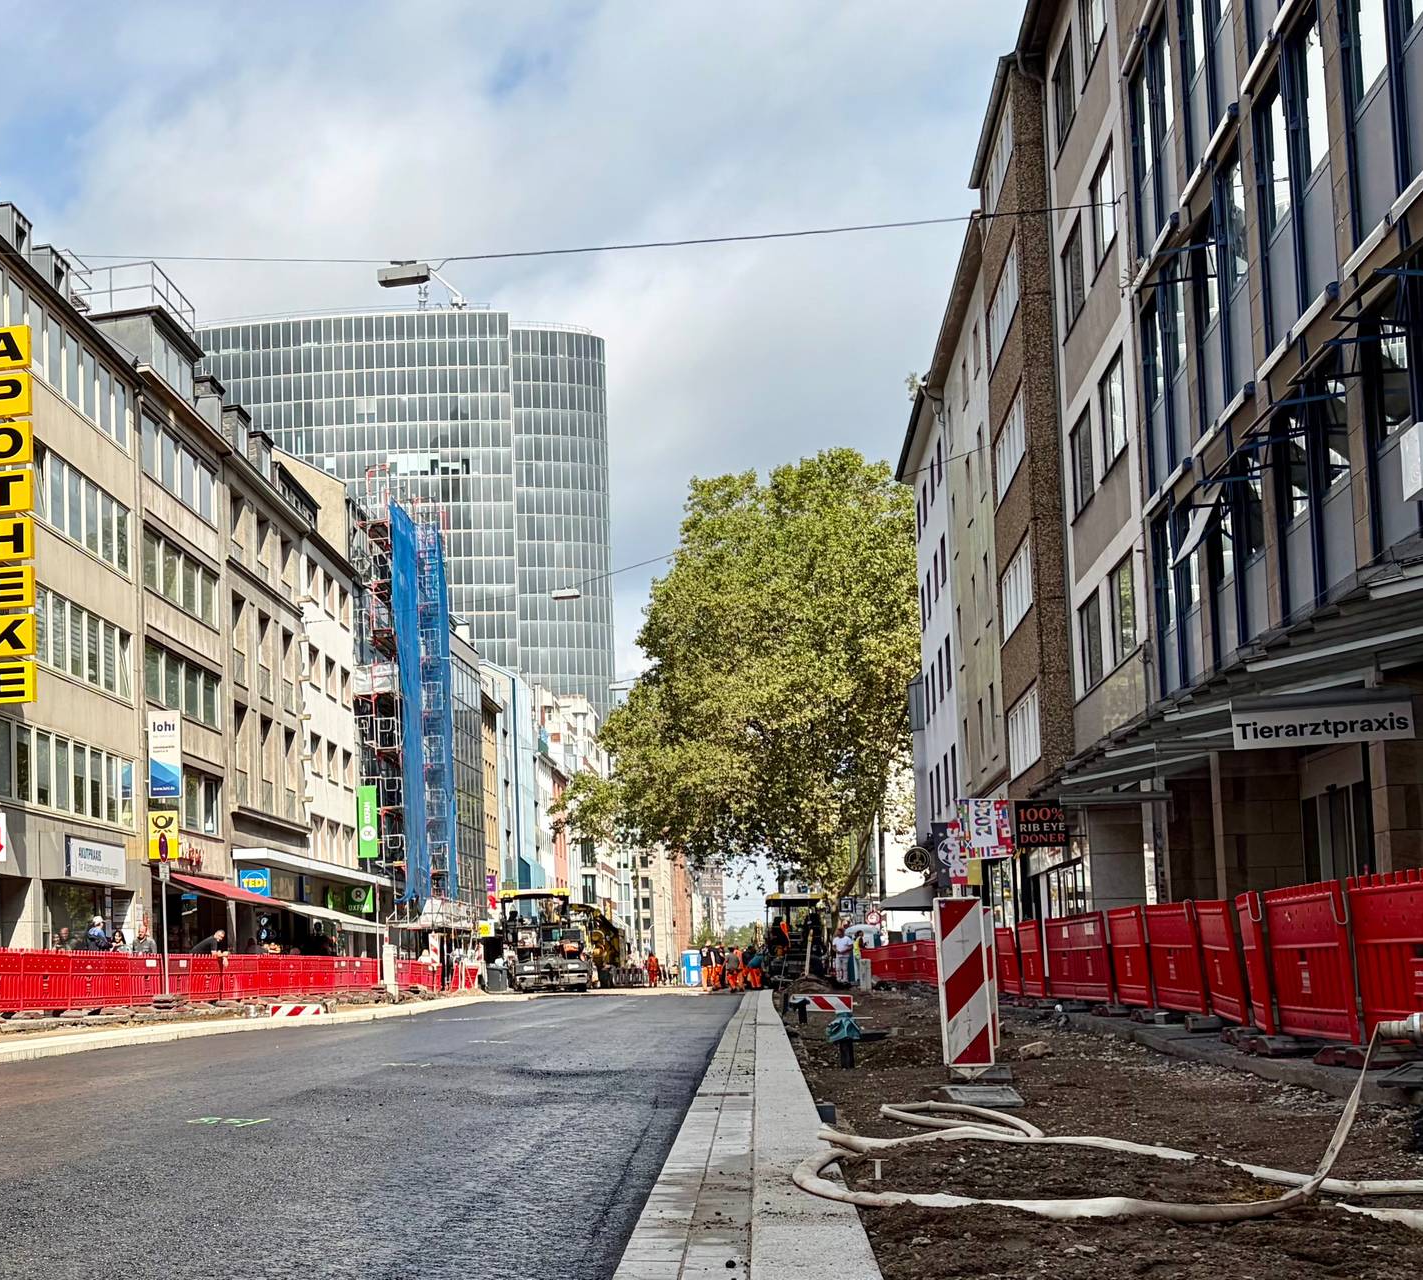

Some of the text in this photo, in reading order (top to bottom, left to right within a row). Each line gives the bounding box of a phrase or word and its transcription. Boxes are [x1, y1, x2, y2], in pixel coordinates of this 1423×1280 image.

[153, 720, 175, 732] lohi
[1236, 712, 1409, 740] Tierarztpraxis
[1019, 808, 1065, 822] 100%
[1019, 822, 1066, 832] RIB EYE
[348, 903, 370, 911] OXFAM
